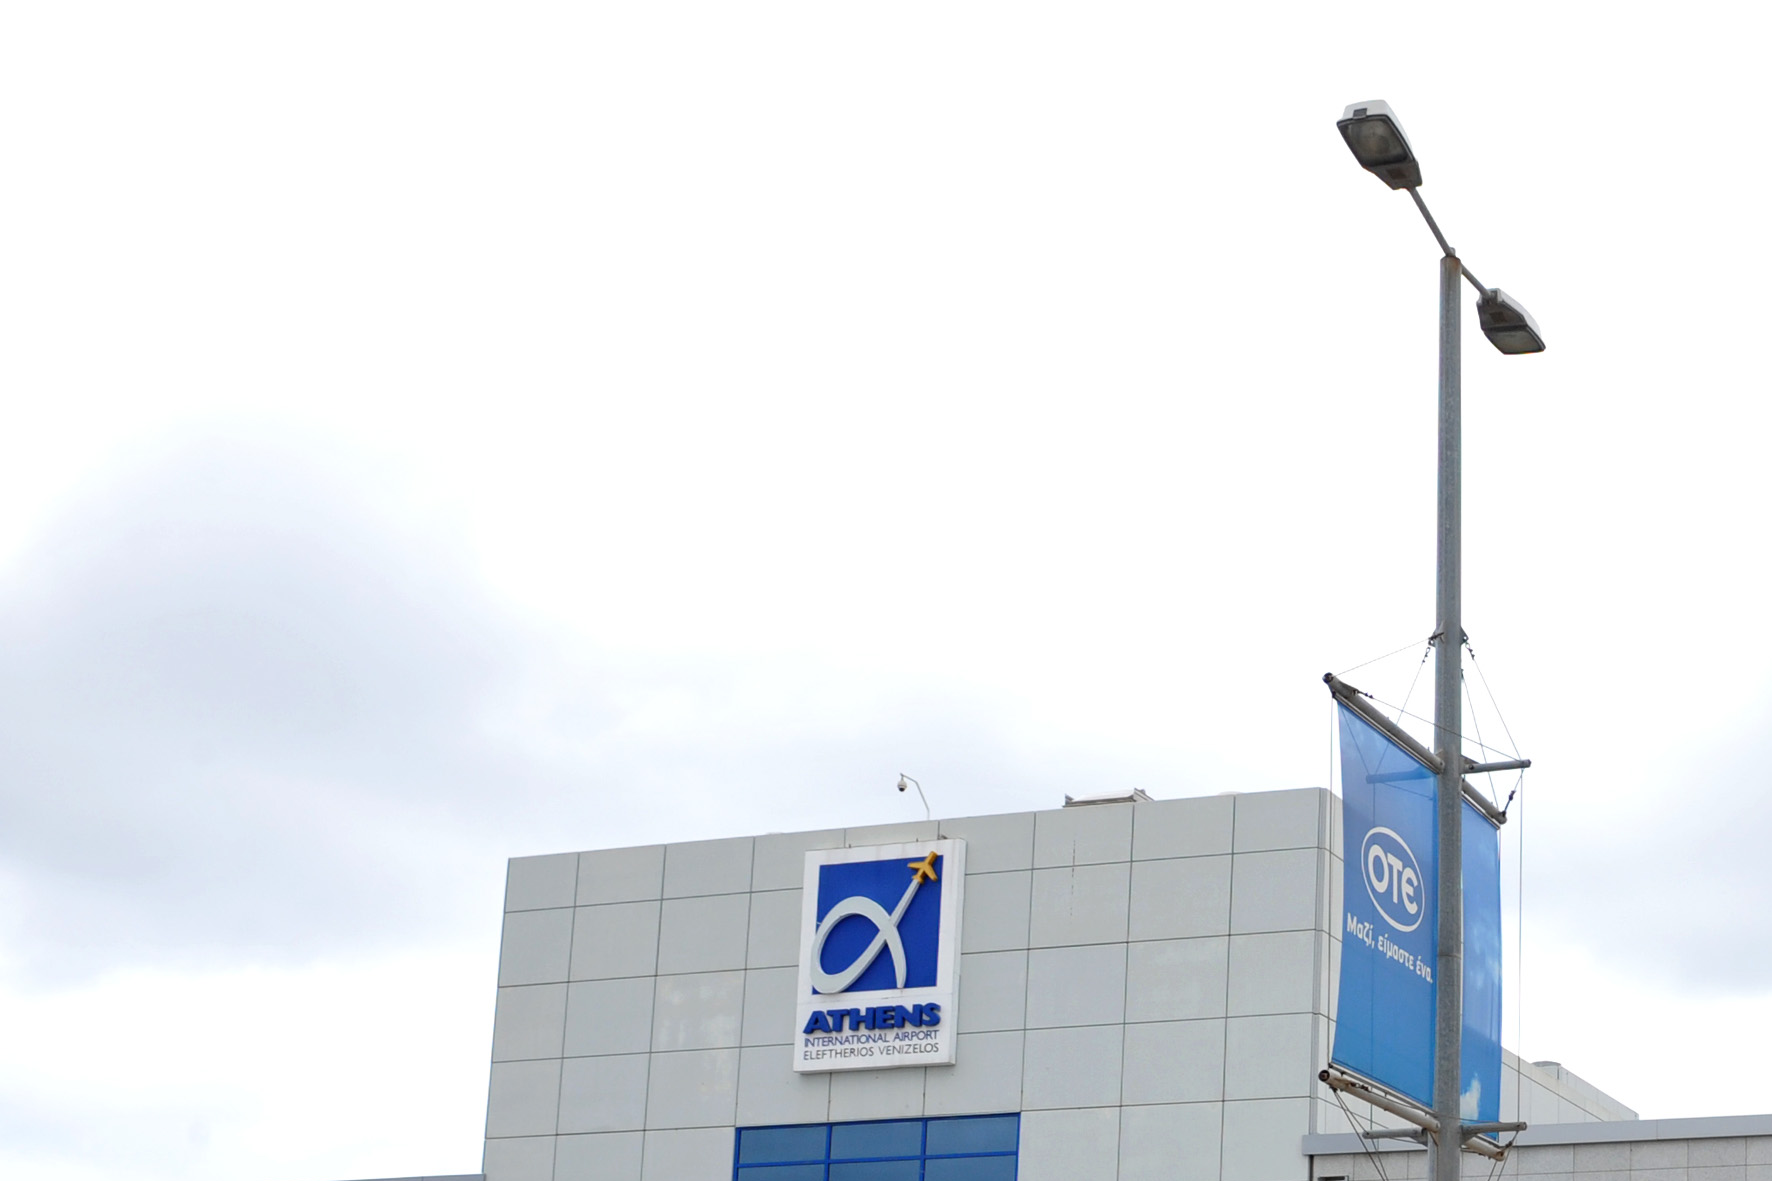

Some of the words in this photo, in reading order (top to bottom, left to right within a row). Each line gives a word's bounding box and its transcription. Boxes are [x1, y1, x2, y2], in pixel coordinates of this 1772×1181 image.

[1347, 912, 1375, 950] Μαζί,
[1377, 934, 1414, 970] είμαστε
[1416, 956, 1433, 983] ένα.
[803, 1003, 941, 1034] ATHENS
[804, 1032, 889, 1047] INTERNATIONAL
[893, 1029, 940, 1044] AIRPORT
[803, 1046, 874, 1061] ELEFTHERIOS
[879, 1042, 939, 1057] VENIZELOS
